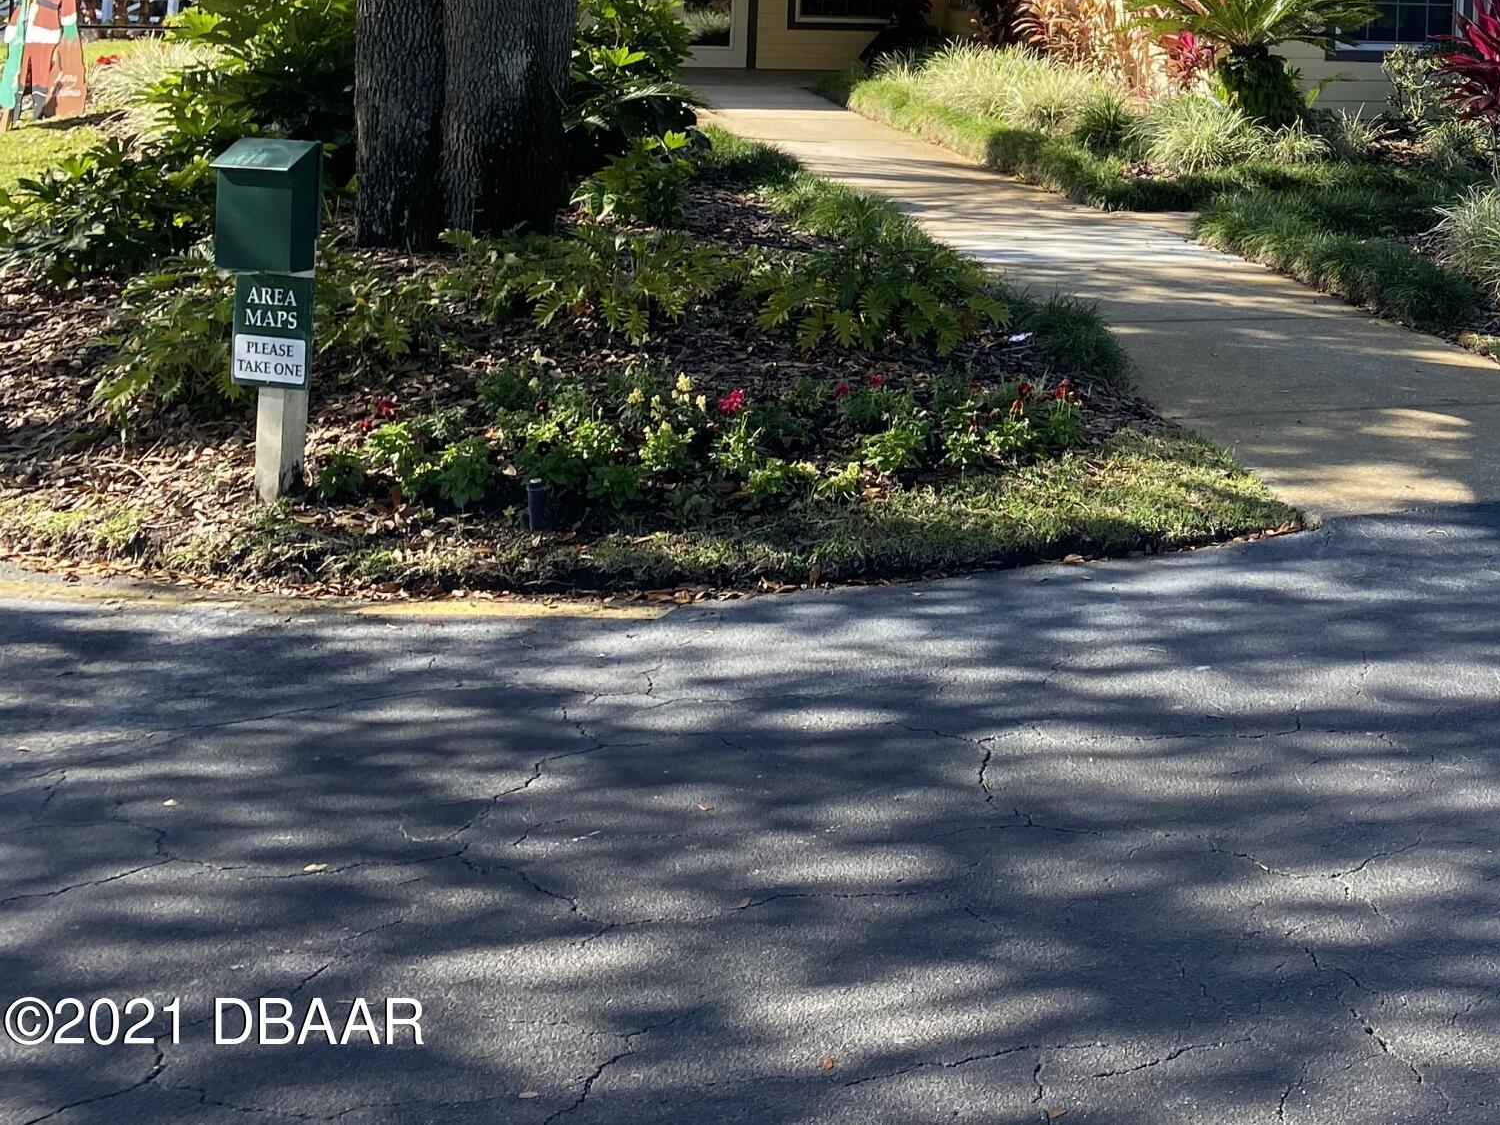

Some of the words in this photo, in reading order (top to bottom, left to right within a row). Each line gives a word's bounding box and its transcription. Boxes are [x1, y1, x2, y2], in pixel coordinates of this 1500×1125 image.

[247, 286, 297, 306] AREA
[245, 308, 297, 329] MAPS
[246, 341, 294, 357] PLEASE
[237, 359, 271, 374] TAKE
[274, 362, 302, 377] ONE
